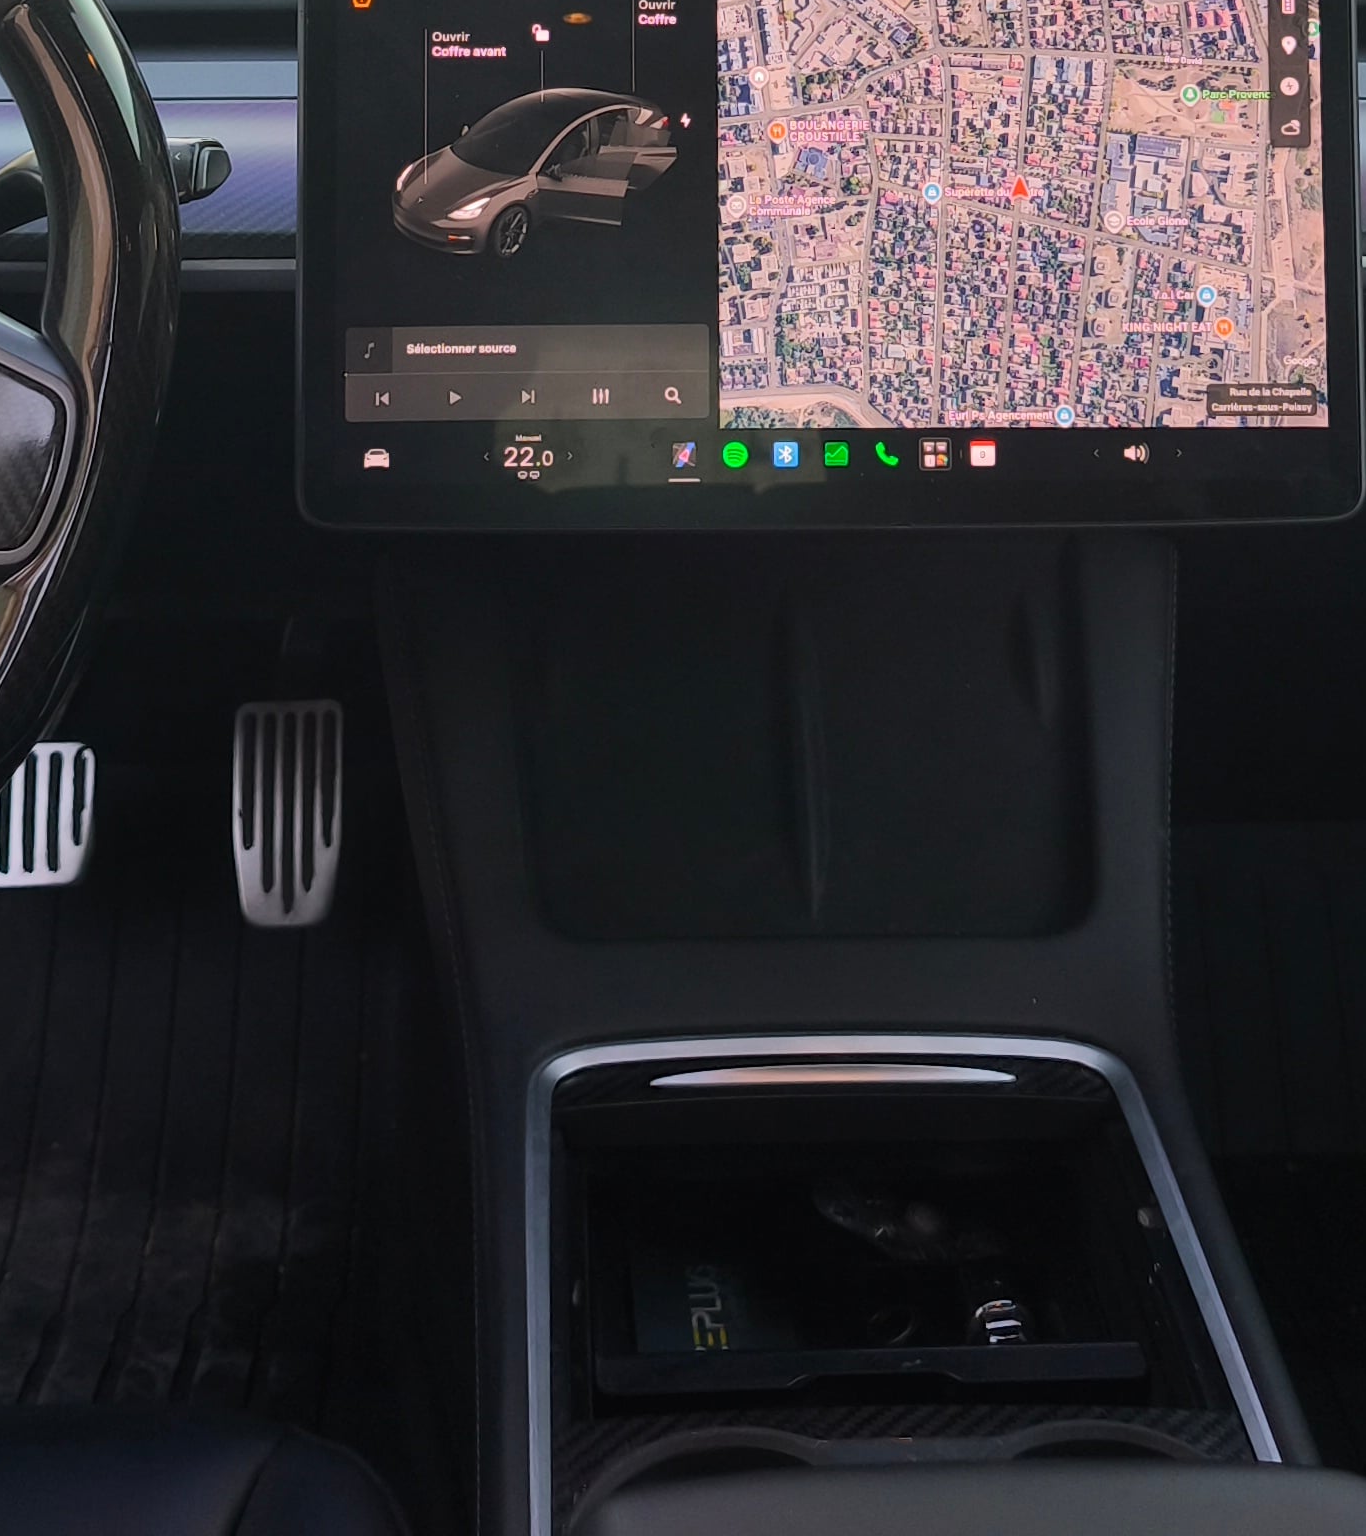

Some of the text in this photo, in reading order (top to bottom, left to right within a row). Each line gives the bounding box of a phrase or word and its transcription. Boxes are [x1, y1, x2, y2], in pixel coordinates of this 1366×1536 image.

[638, 0, 676, 10] Ouvrir
[638, 14, 677, 26] Coffre
[432, 31, 470, 42] Ouvrir
[432, 46, 507, 57] Coffre avant
[1202, 90, 1227, 100] Parc
[790, 120, 870, 131] BOULANGERIE
[790, 132, 860, 142] CROUSTILLE
[945, 187, 996, 199] Supérette
[998, 187, 1010, 197] du
[749, 195, 835, 207] La Poste Agence
[749, 207, 810, 216] Communale
[1126, 216, 1157, 226] Ecole
[1176, 290, 1194, 300] Car
[1122, 322, 1212, 332] KING NIGHT EAT
[406, 343, 517, 355] Sélectionner source
[1283, 355, 1317, 367] Google
[1229, 387, 1312, 398] Rue de la Chapelle
[972, 410, 985, 420] Ps
[988, 410, 1053, 422] Agencement
[503, 447, 554, 467] 22.0
